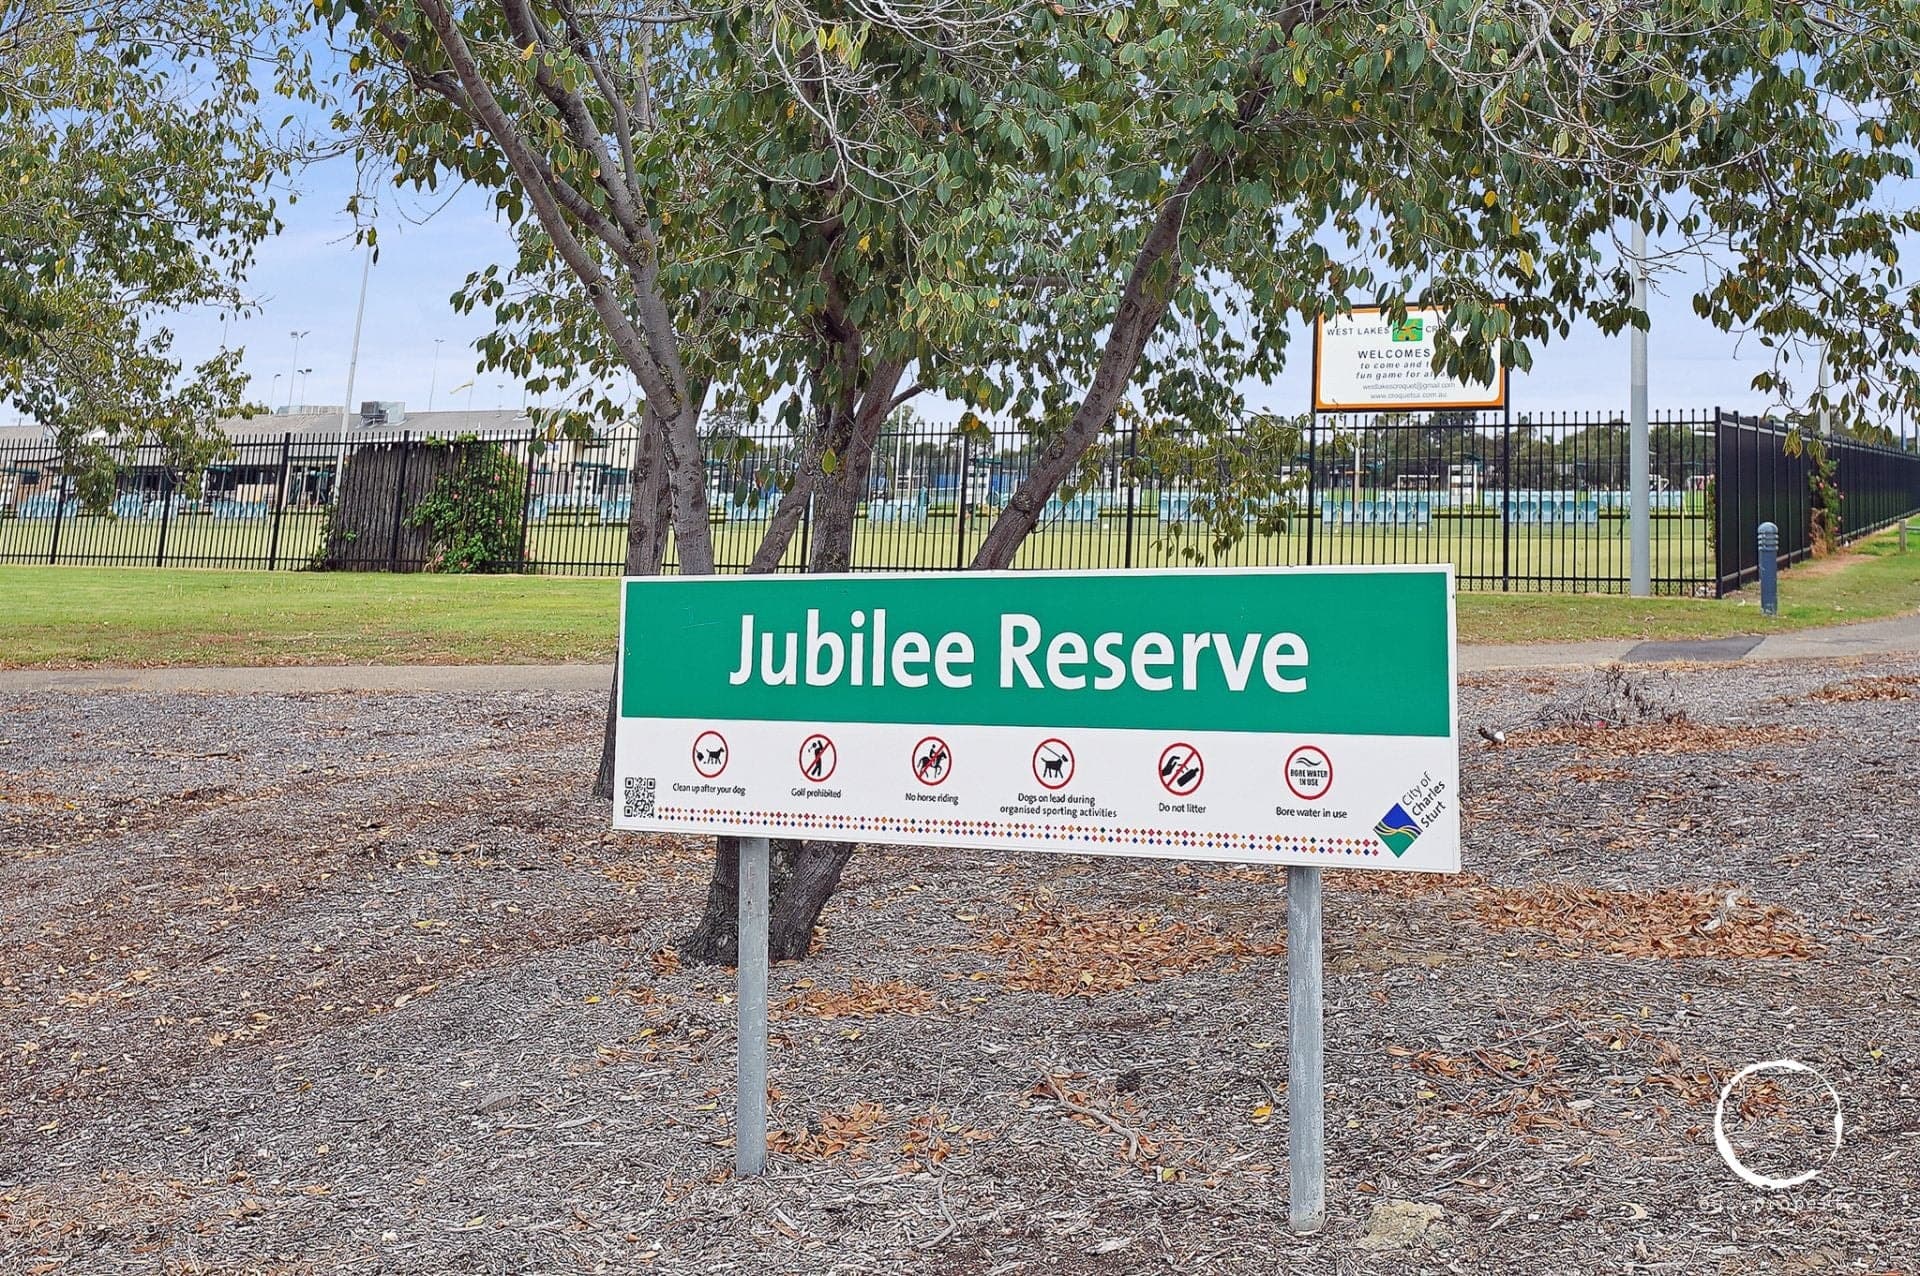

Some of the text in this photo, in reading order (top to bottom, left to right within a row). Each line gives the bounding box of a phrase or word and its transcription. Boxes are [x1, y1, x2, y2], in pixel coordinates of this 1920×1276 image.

[1327, 327, 1354, 336] WEST
[1357, 326, 1390, 335] LAKES
[1358, 348, 1431, 359] WELCOMES
[1373, 361, 1401, 369] come
[1403, 360, 1423, 369] and
[1375, 371, 1403, 380] game
[1405, 370, 1421, 378] for
[729, 608, 1310, 693] Jubilee Reserve
[1290, 768, 1328, 778] BORE WATER
[1299, 778, 1319, 787] IN USE
[1401, 770, 1432, 806] City of
[672, 782, 746, 797] Clean up after your dog
[791, 787, 842, 799] Golf prohibited
[905, 792, 959, 806] No horse riding
[1018, 792, 1096, 807] Dogs on lead during
[1411, 780, 1446, 817] Charles
[999, 805, 1118, 819] organised sporting activities
[1158, 802, 1207, 813] Do not litter
[1276, 806, 1348, 819] Bore water in use
[1420, 800, 1447, 828] Sturt
